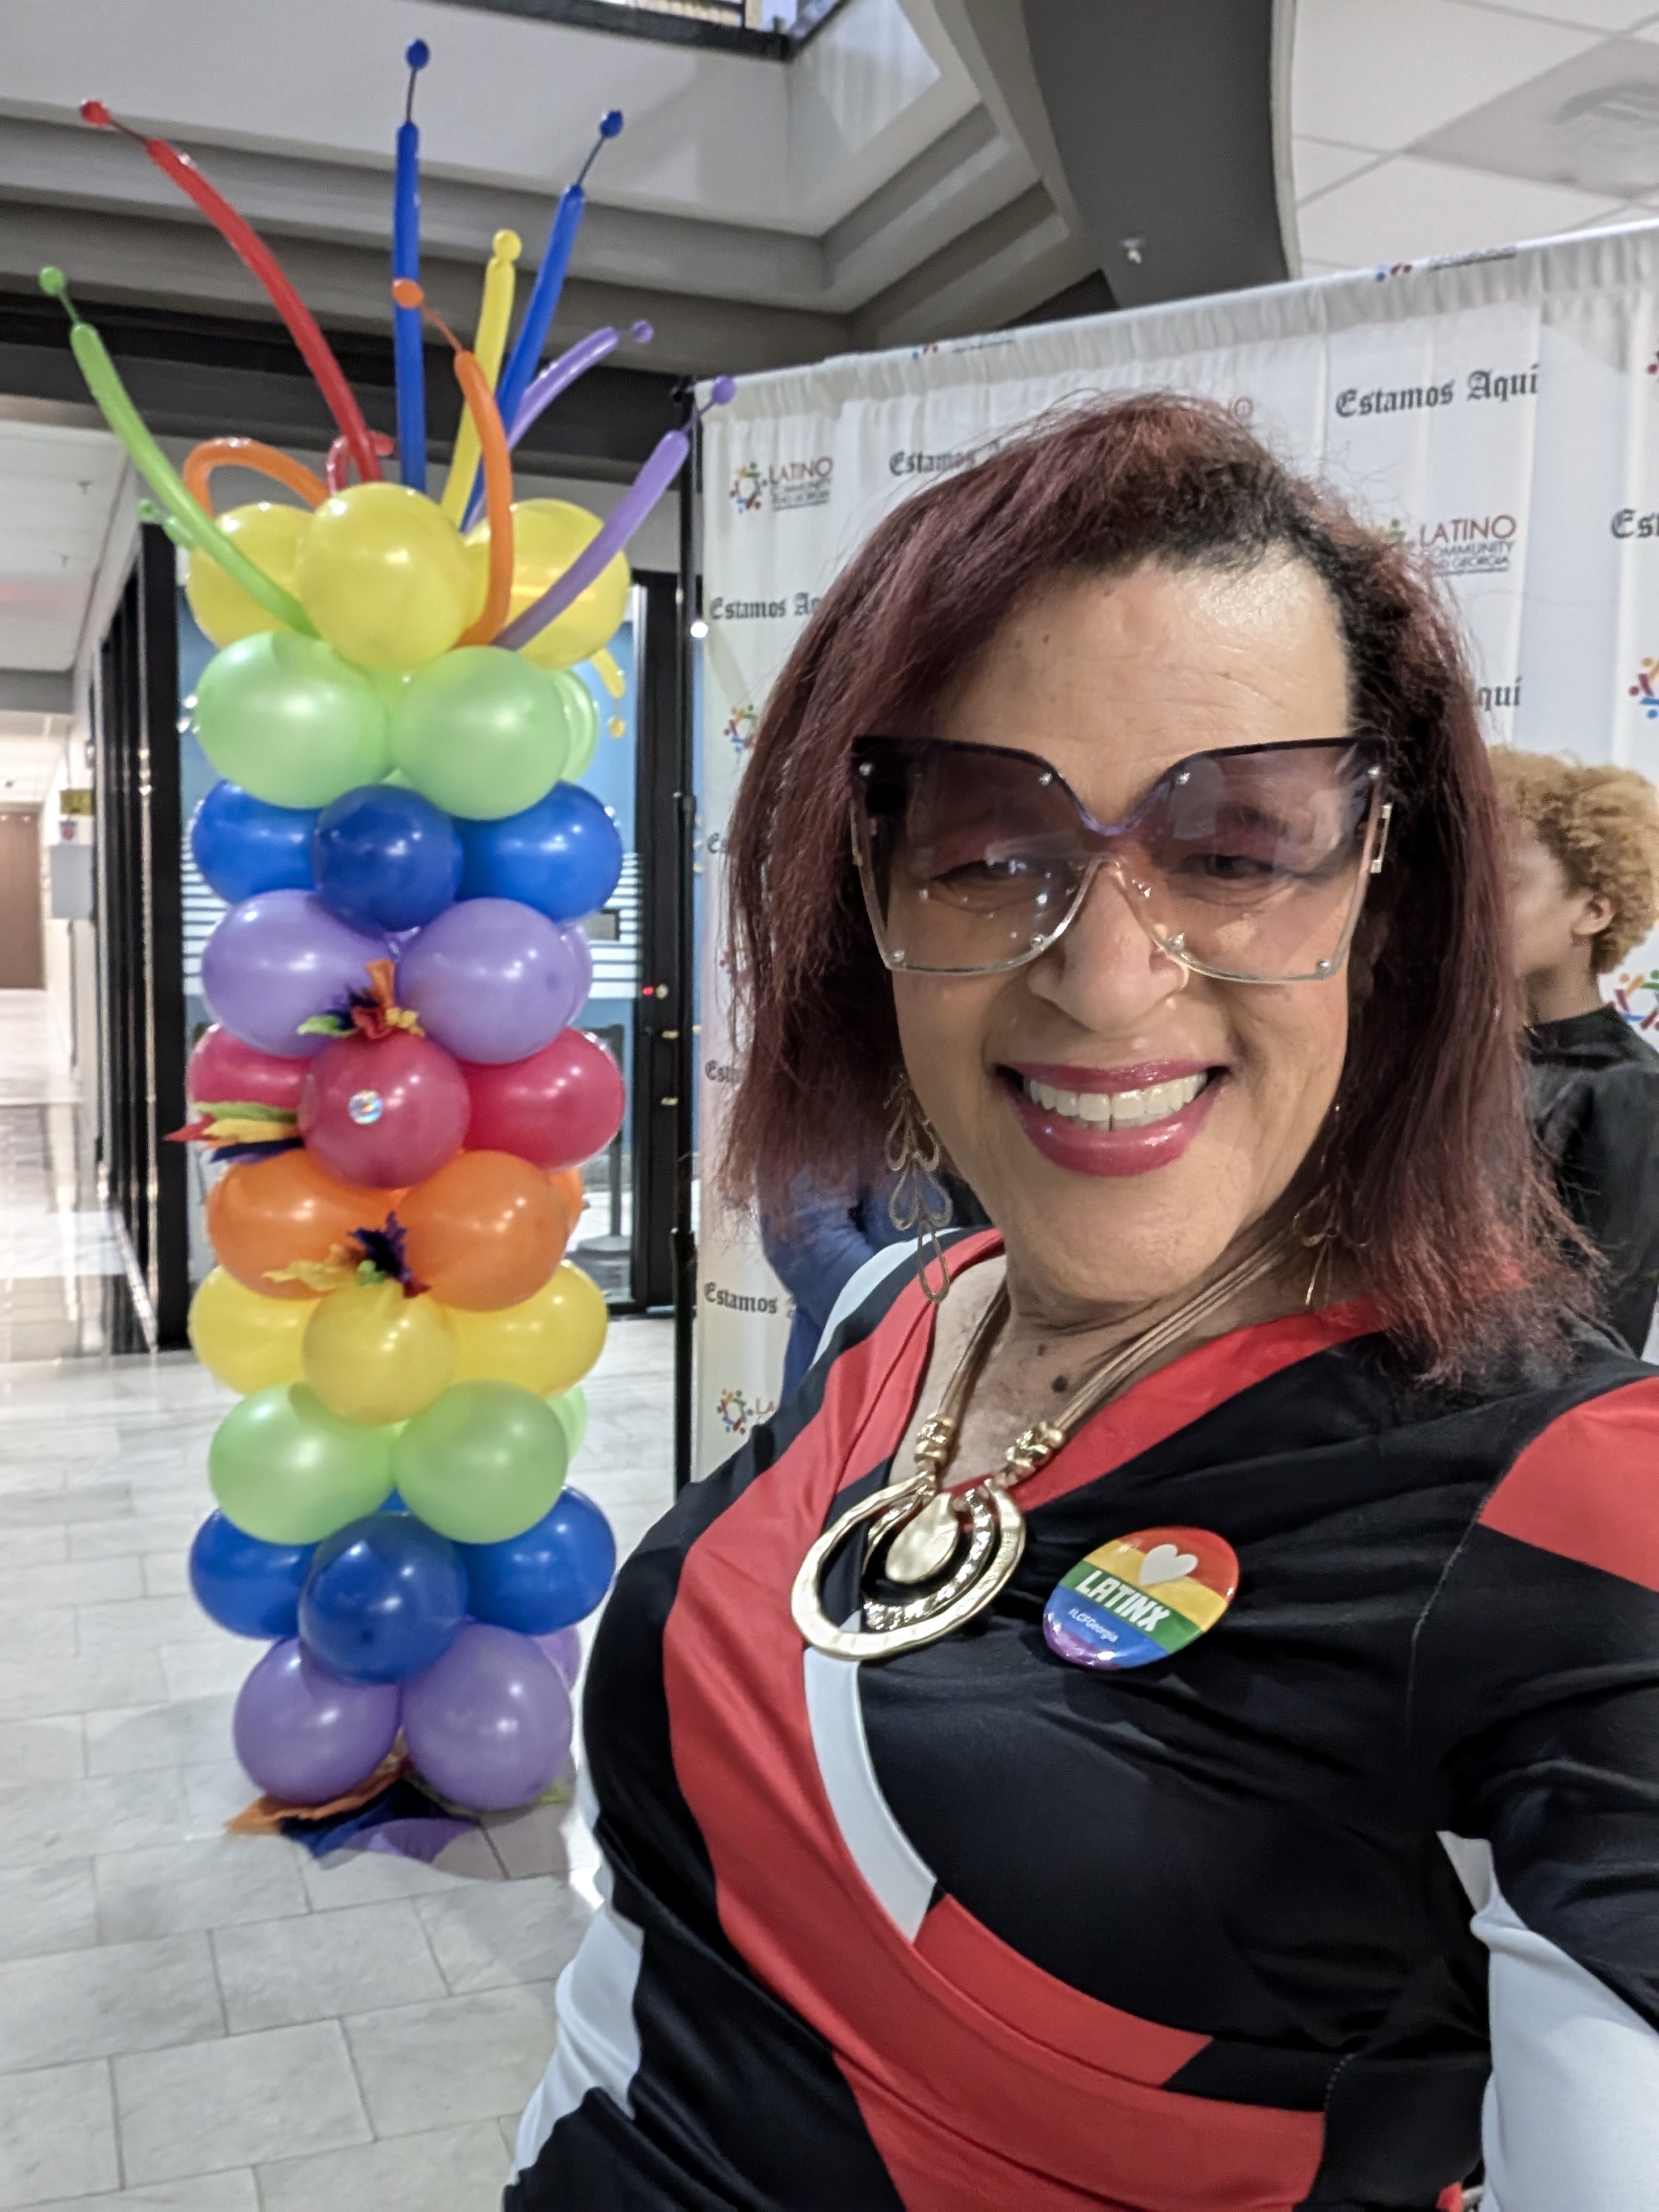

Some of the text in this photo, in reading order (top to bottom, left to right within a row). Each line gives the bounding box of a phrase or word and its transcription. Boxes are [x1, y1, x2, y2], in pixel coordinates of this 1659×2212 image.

[1336, 364, 1540, 418] Estamos Aquí
[769, 456, 833, 485] LATINO
[1419, 515, 1516, 547] LATINO
[709, 596, 786, 620] Estamos
[1478, 676, 1523, 712] quí
[704, 1281, 778, 1315] Estamos
[1074, 1570, 1170, 1632] LATINX
